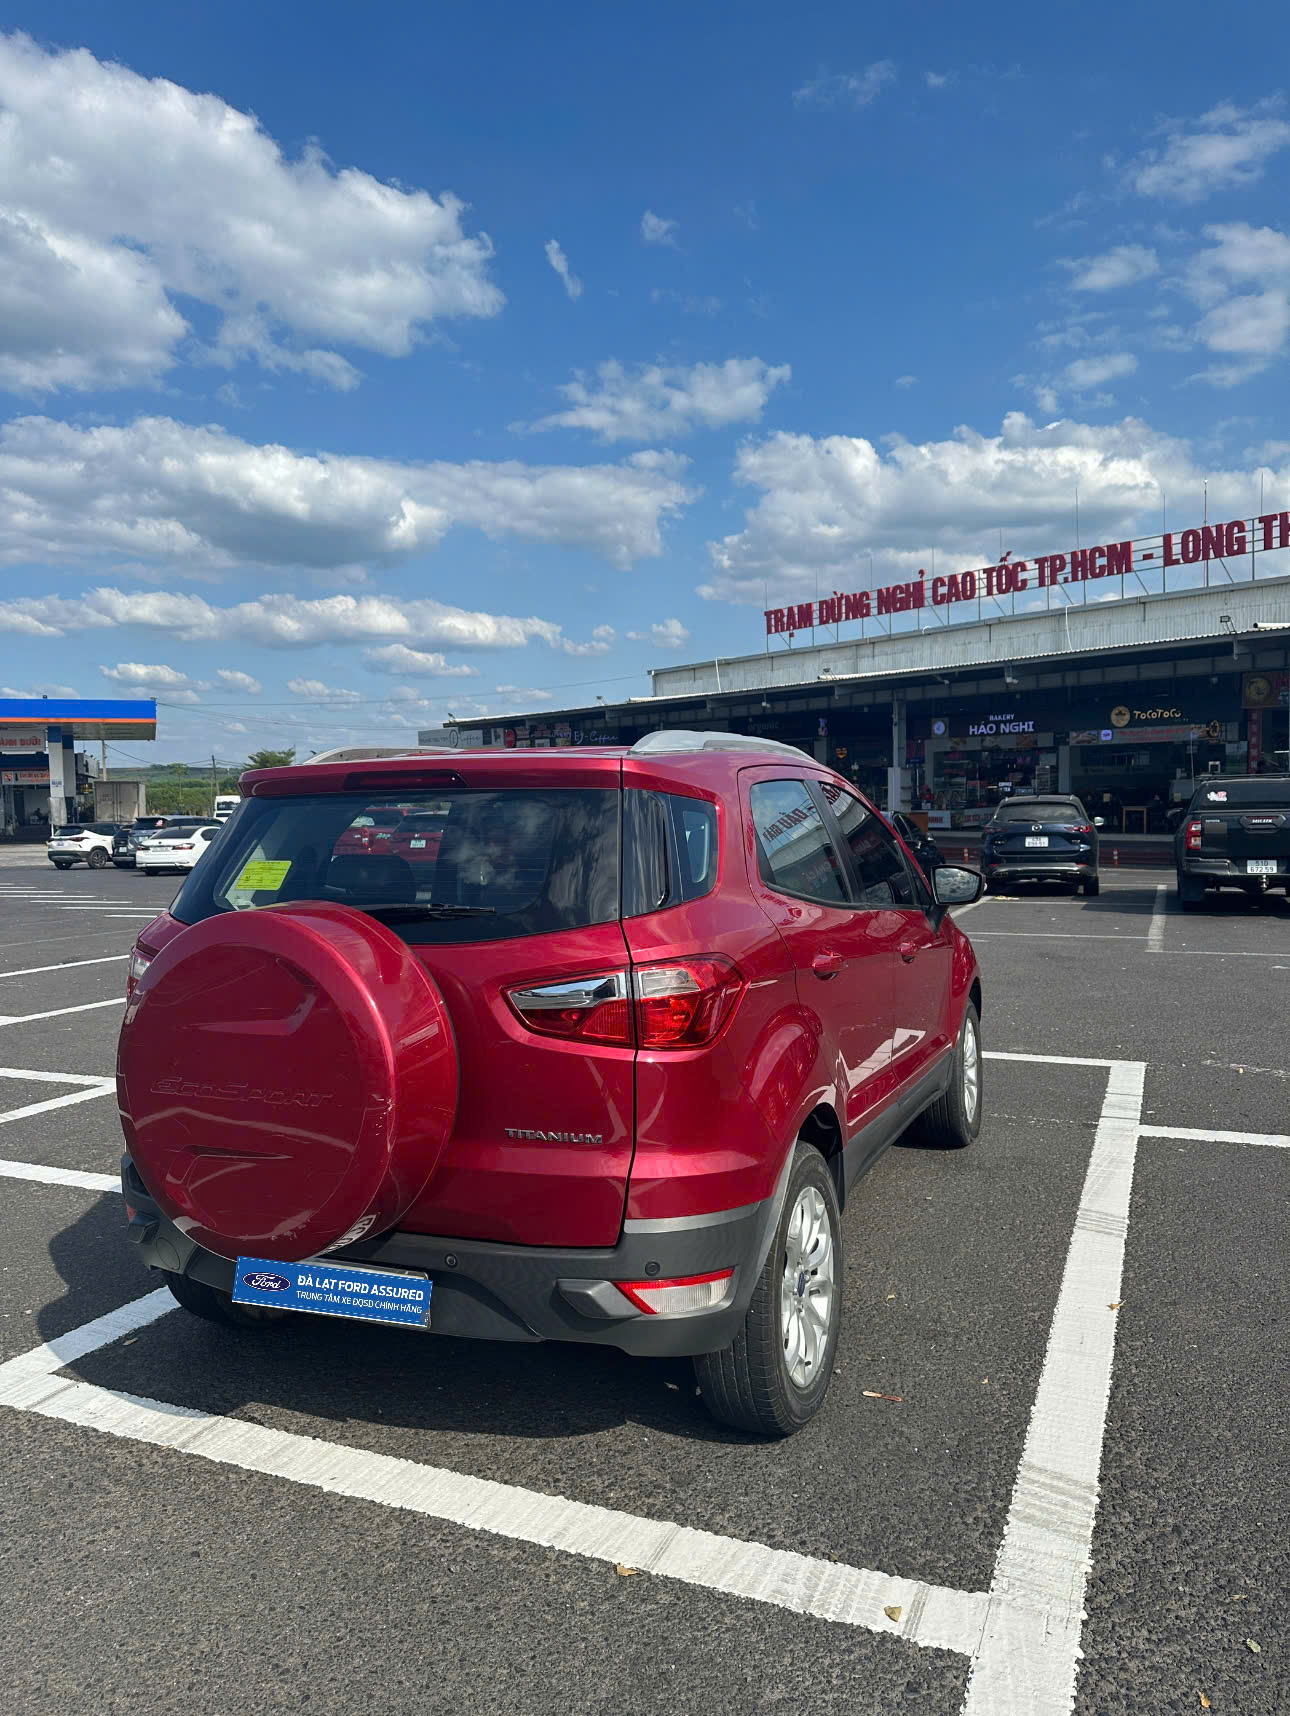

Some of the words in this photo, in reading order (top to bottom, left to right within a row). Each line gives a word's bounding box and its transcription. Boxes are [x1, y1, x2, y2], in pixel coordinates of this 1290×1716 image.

[764, 602, 814, 637] TRẠM
[819, 591, 871, 625] DỪNG
[877, 569, 926, 615] NGHỈ
[932, 571, 976, 606] CAO
[983, 551, 1029, 596] TỐC
[1034, 541, 1132, 588] TP.HCM
[1163, 520, 1247, 567] LONG
[989, 713, 1015, 721] BAKERY
[504, 1127, 603, 1145] TITANIUM
[252, 1274, 282, 1289] Ford
[297, 1273, 313, 1287] ĐÀ
[316, 1277, 338, 1291] LẠT
[338, 1280, 369, 1294] FORD
[370, 1284, 424, 1301] ASSURED
[296, 1290, 323, 1301] TRUNG
[324, 1292, 340, 1304] TÂM
[341, 1296, 352, 1305] XE
[374, 1300, 400, 1311] CHÍNH
